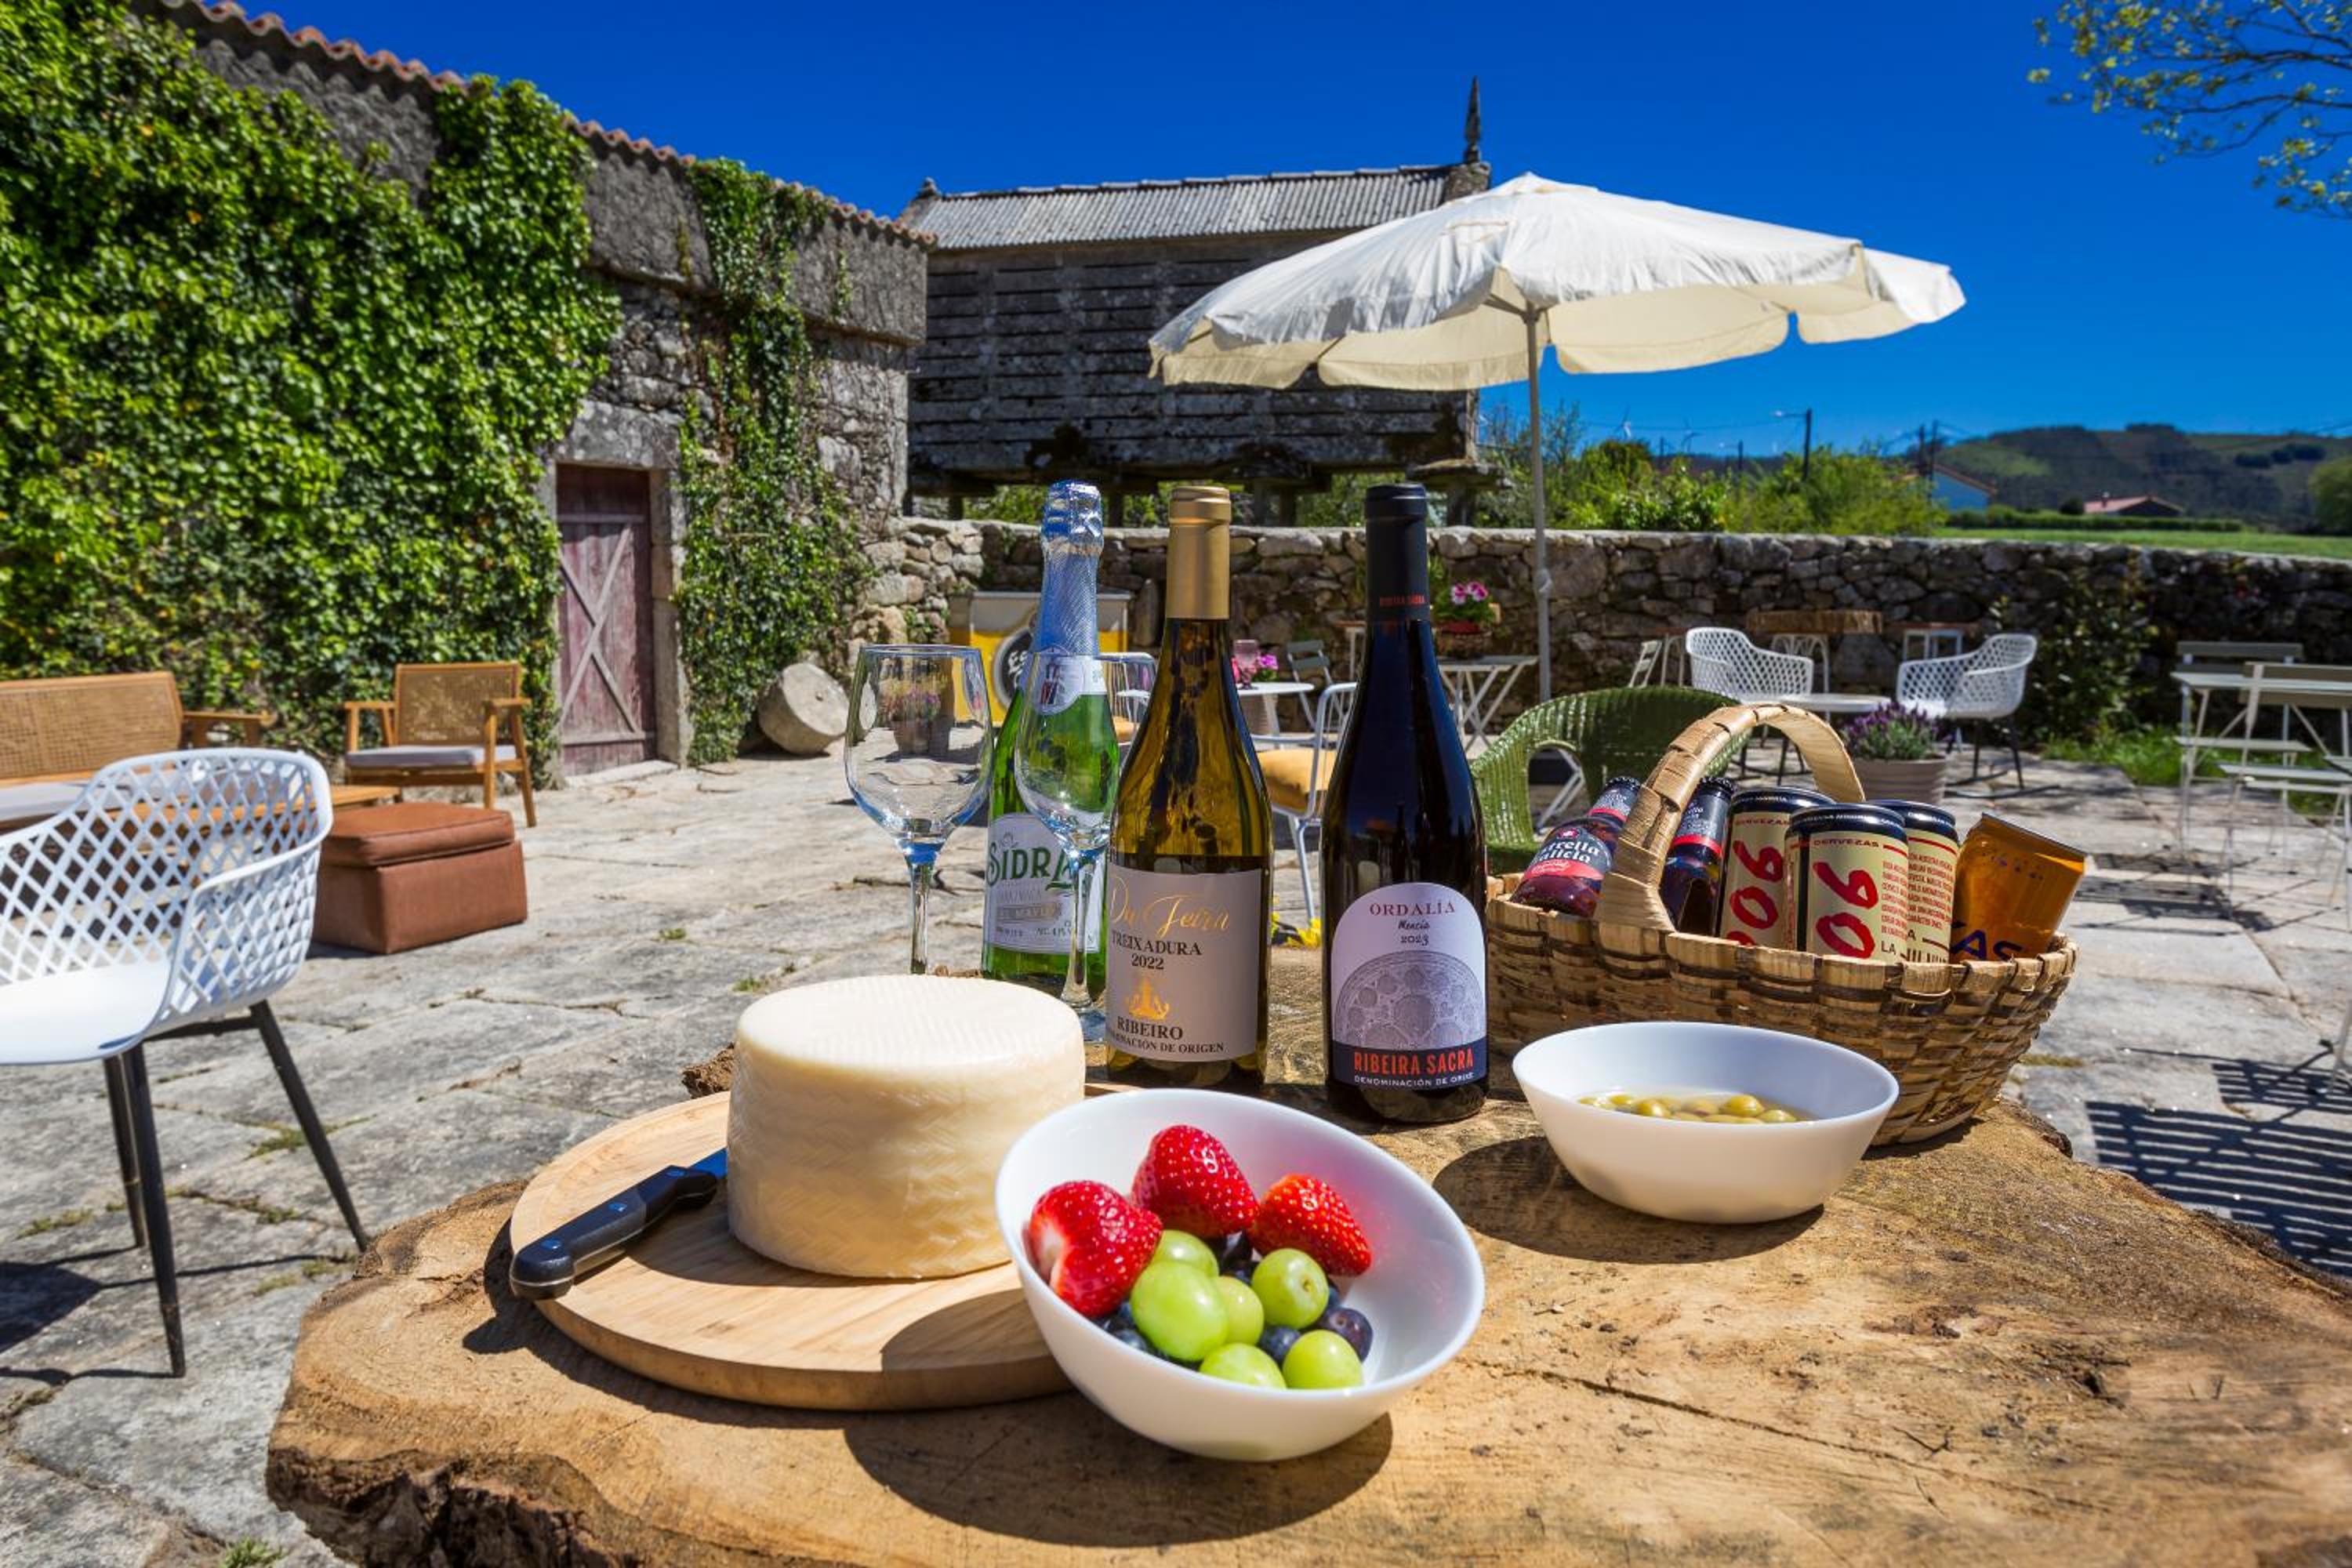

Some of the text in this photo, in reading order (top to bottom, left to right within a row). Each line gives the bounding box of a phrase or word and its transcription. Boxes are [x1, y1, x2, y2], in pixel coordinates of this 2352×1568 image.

[1813, 837, 1880, 848] CERVEZAS
[1111, 930, 1203, 956] TREIXADURA
[1131, 953, 1165, 971] 2022
[1116, 1016, 1184, 1041] RIBEIRO
[1160, 1041, 1176, 1053] DE
[1178, 1042, 1225, 1054] ORIGEN
[1353, 1047, 1475, 1076] RIBEIRA SACRA
[1435, 1077, 1448, 1086] DE
